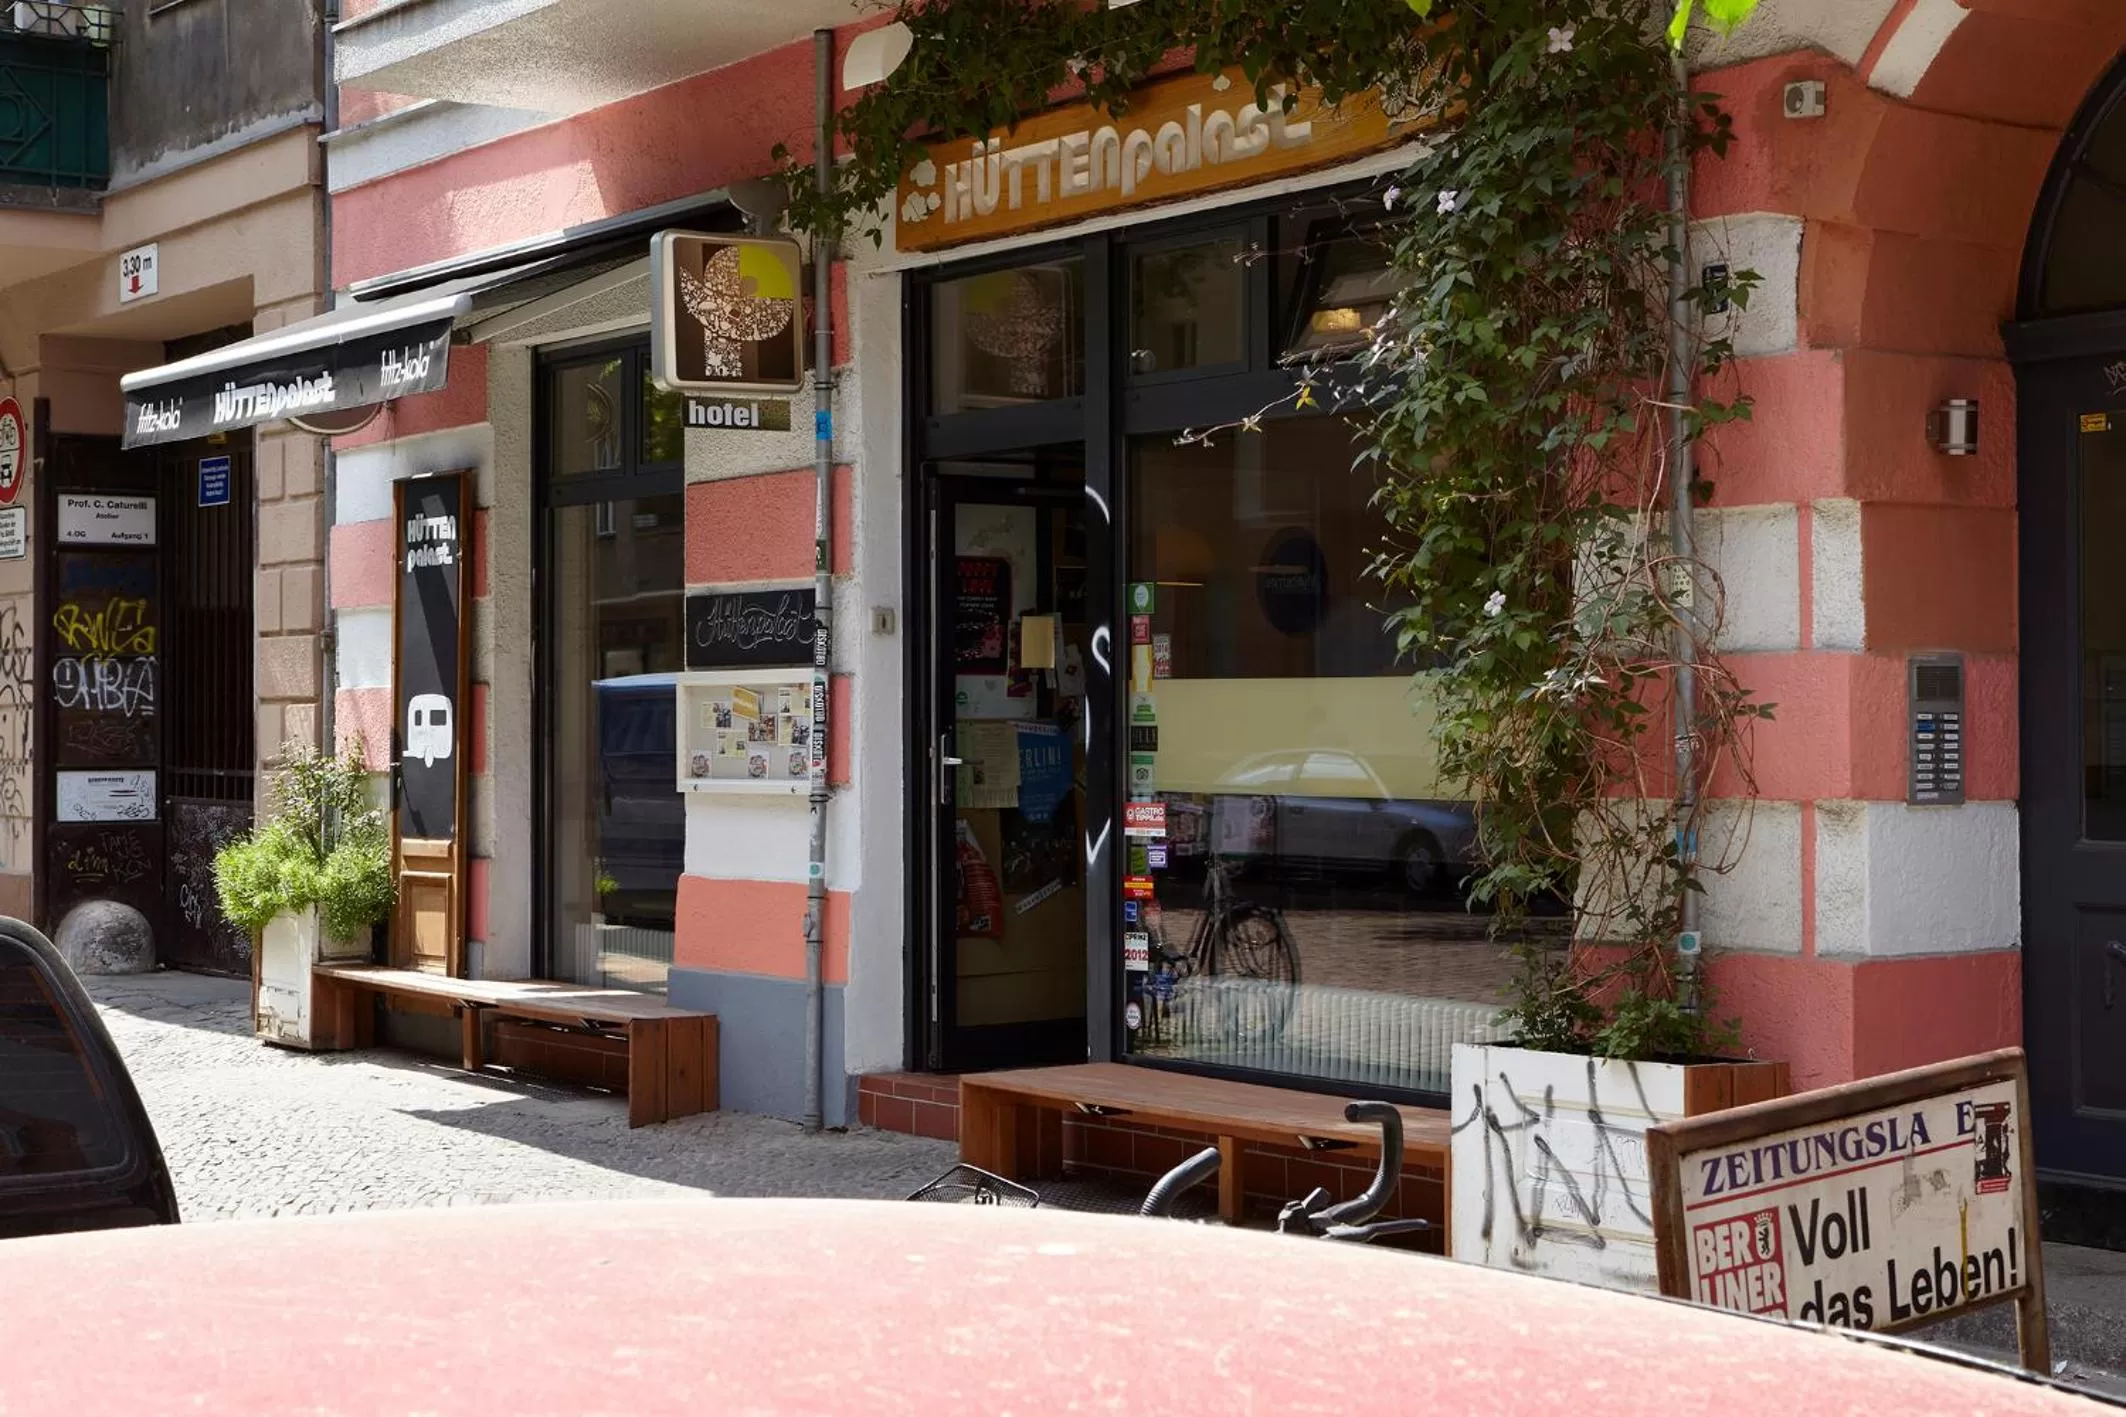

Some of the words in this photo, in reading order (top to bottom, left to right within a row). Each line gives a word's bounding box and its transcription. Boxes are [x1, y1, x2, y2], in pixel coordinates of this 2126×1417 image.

[143, 257, 152, 270] m
[380, 344, 432, 387] fritz-kola
[136, 398, 183, 435] fritz-kola
[688, 401, 760, 428] hotel
[67, 499, 91, 508] Prof.
[93, 500, 104, 509] C.
[111, 532, 142, 540] Aufgang
[407, 542, 453, 573] palast
[1125, 949, 1149, 961] 2012
[1789, 1186, 1871, 1267] Voll
[1800, 1279, 1875, 1331] das
[1886, 1227, 2018, 1322] Leben!
